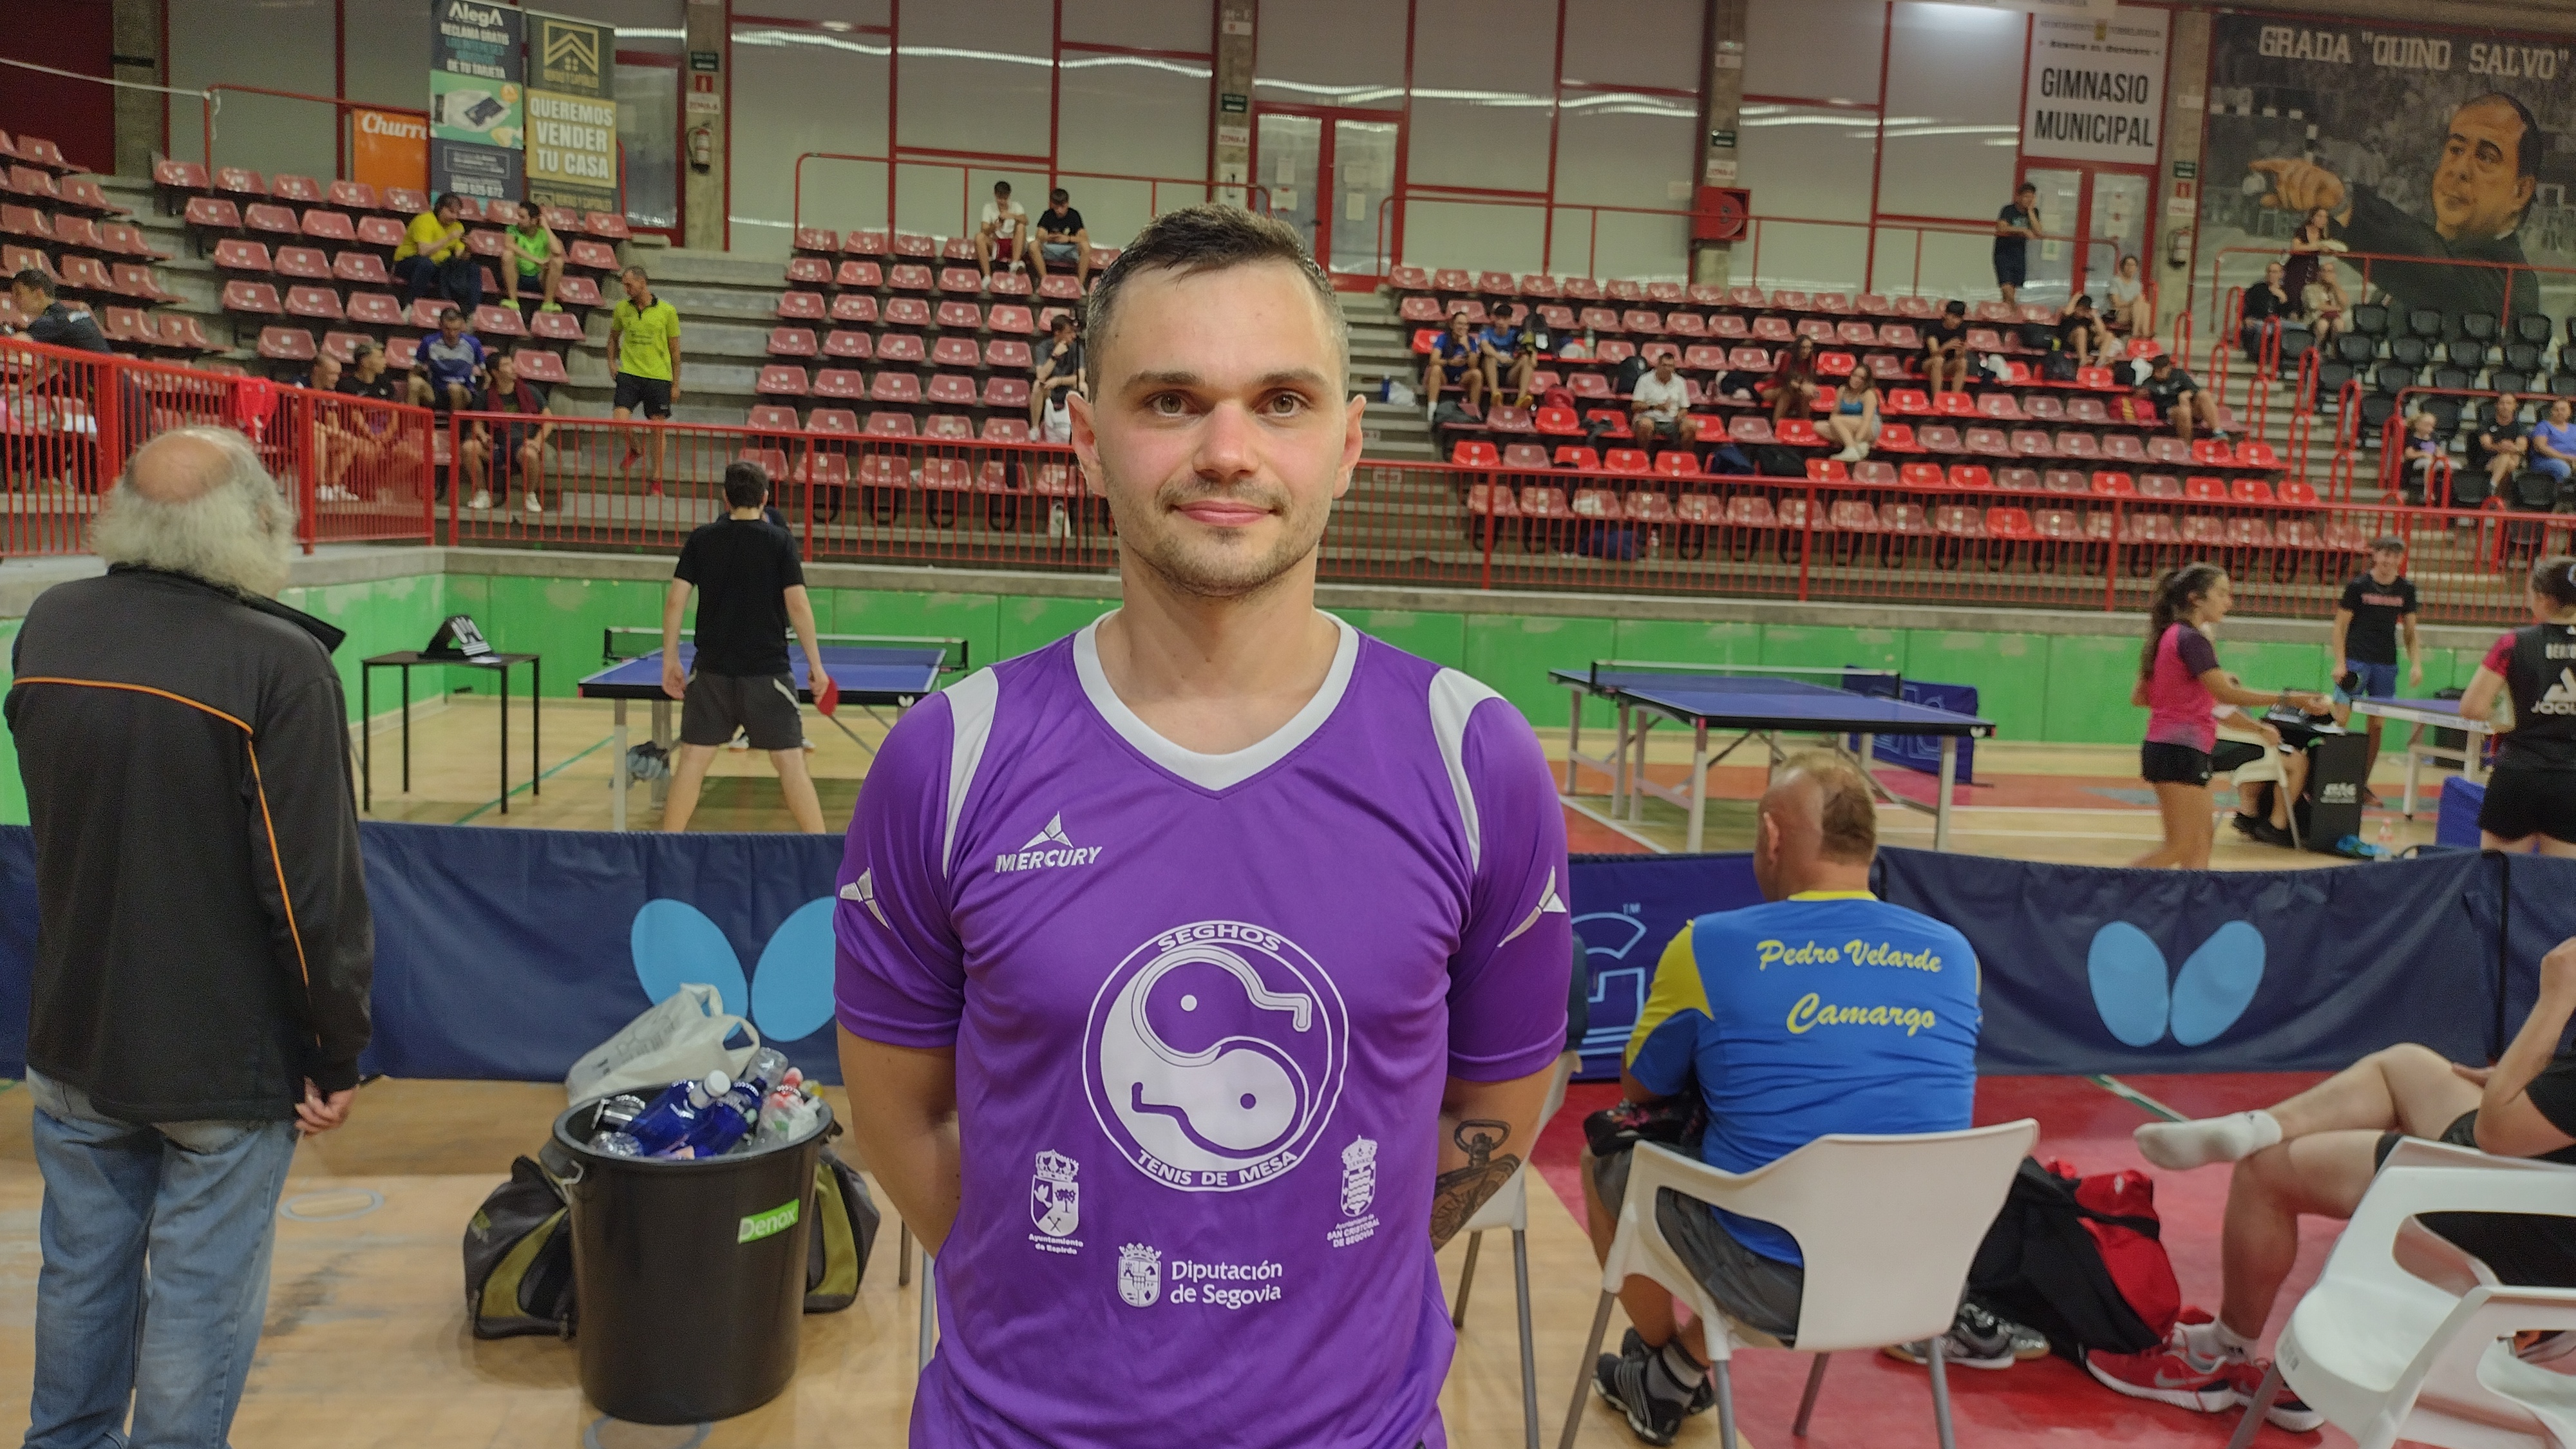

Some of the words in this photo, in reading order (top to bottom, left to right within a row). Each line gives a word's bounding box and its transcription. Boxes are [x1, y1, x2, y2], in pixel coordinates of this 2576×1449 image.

[2259, 25, 2353, 63] GRADA
[2362, 30, 2451, 70] "QUINO
[2468, 42, 2570, 79] SALVO"
[2041, 68, 2148, 104] GIMNASIO
[530, 97, 613, 127] QUEREMOS
[536, 119, 608, 153] VENDER
[2034, 109, 2154, 147] MUNICIPAL
[538, 147, 558, 173] TU
[564, 152, 609, 179] CASA
[994, 846, 1103, 873] MERCURY
[1158, 924, 1281, 952] SEGHOS
[1756, 939, 1841, 971] Pedro
[1844, 938, 1943, 973] Velarde
[1786, 992, 1936, 1037] Camargo
[1138, 1149, 1192, 1184] TENIS
[1202, 1171, 1228, 1186] DE
[1239, 1151, 1298, 1183] MESA
[737, 1207, 797, 1244] Denox
[1028, 1233, 1084, 1247] Ayuntamiento
[1327, 1229, 1343, 1242] SAN
[1333, 1238, 1345, 1248] DE
[1345, 1228, 1374, 1245] SEGOVIA
[1046, 1244, 1077, 1255] Espirdo
[1171, 1260, 1283, 1283] Diputación
[1170, 1283, 1197, 1304] de
[1202, 1283, 1282, 1310] Segovia
